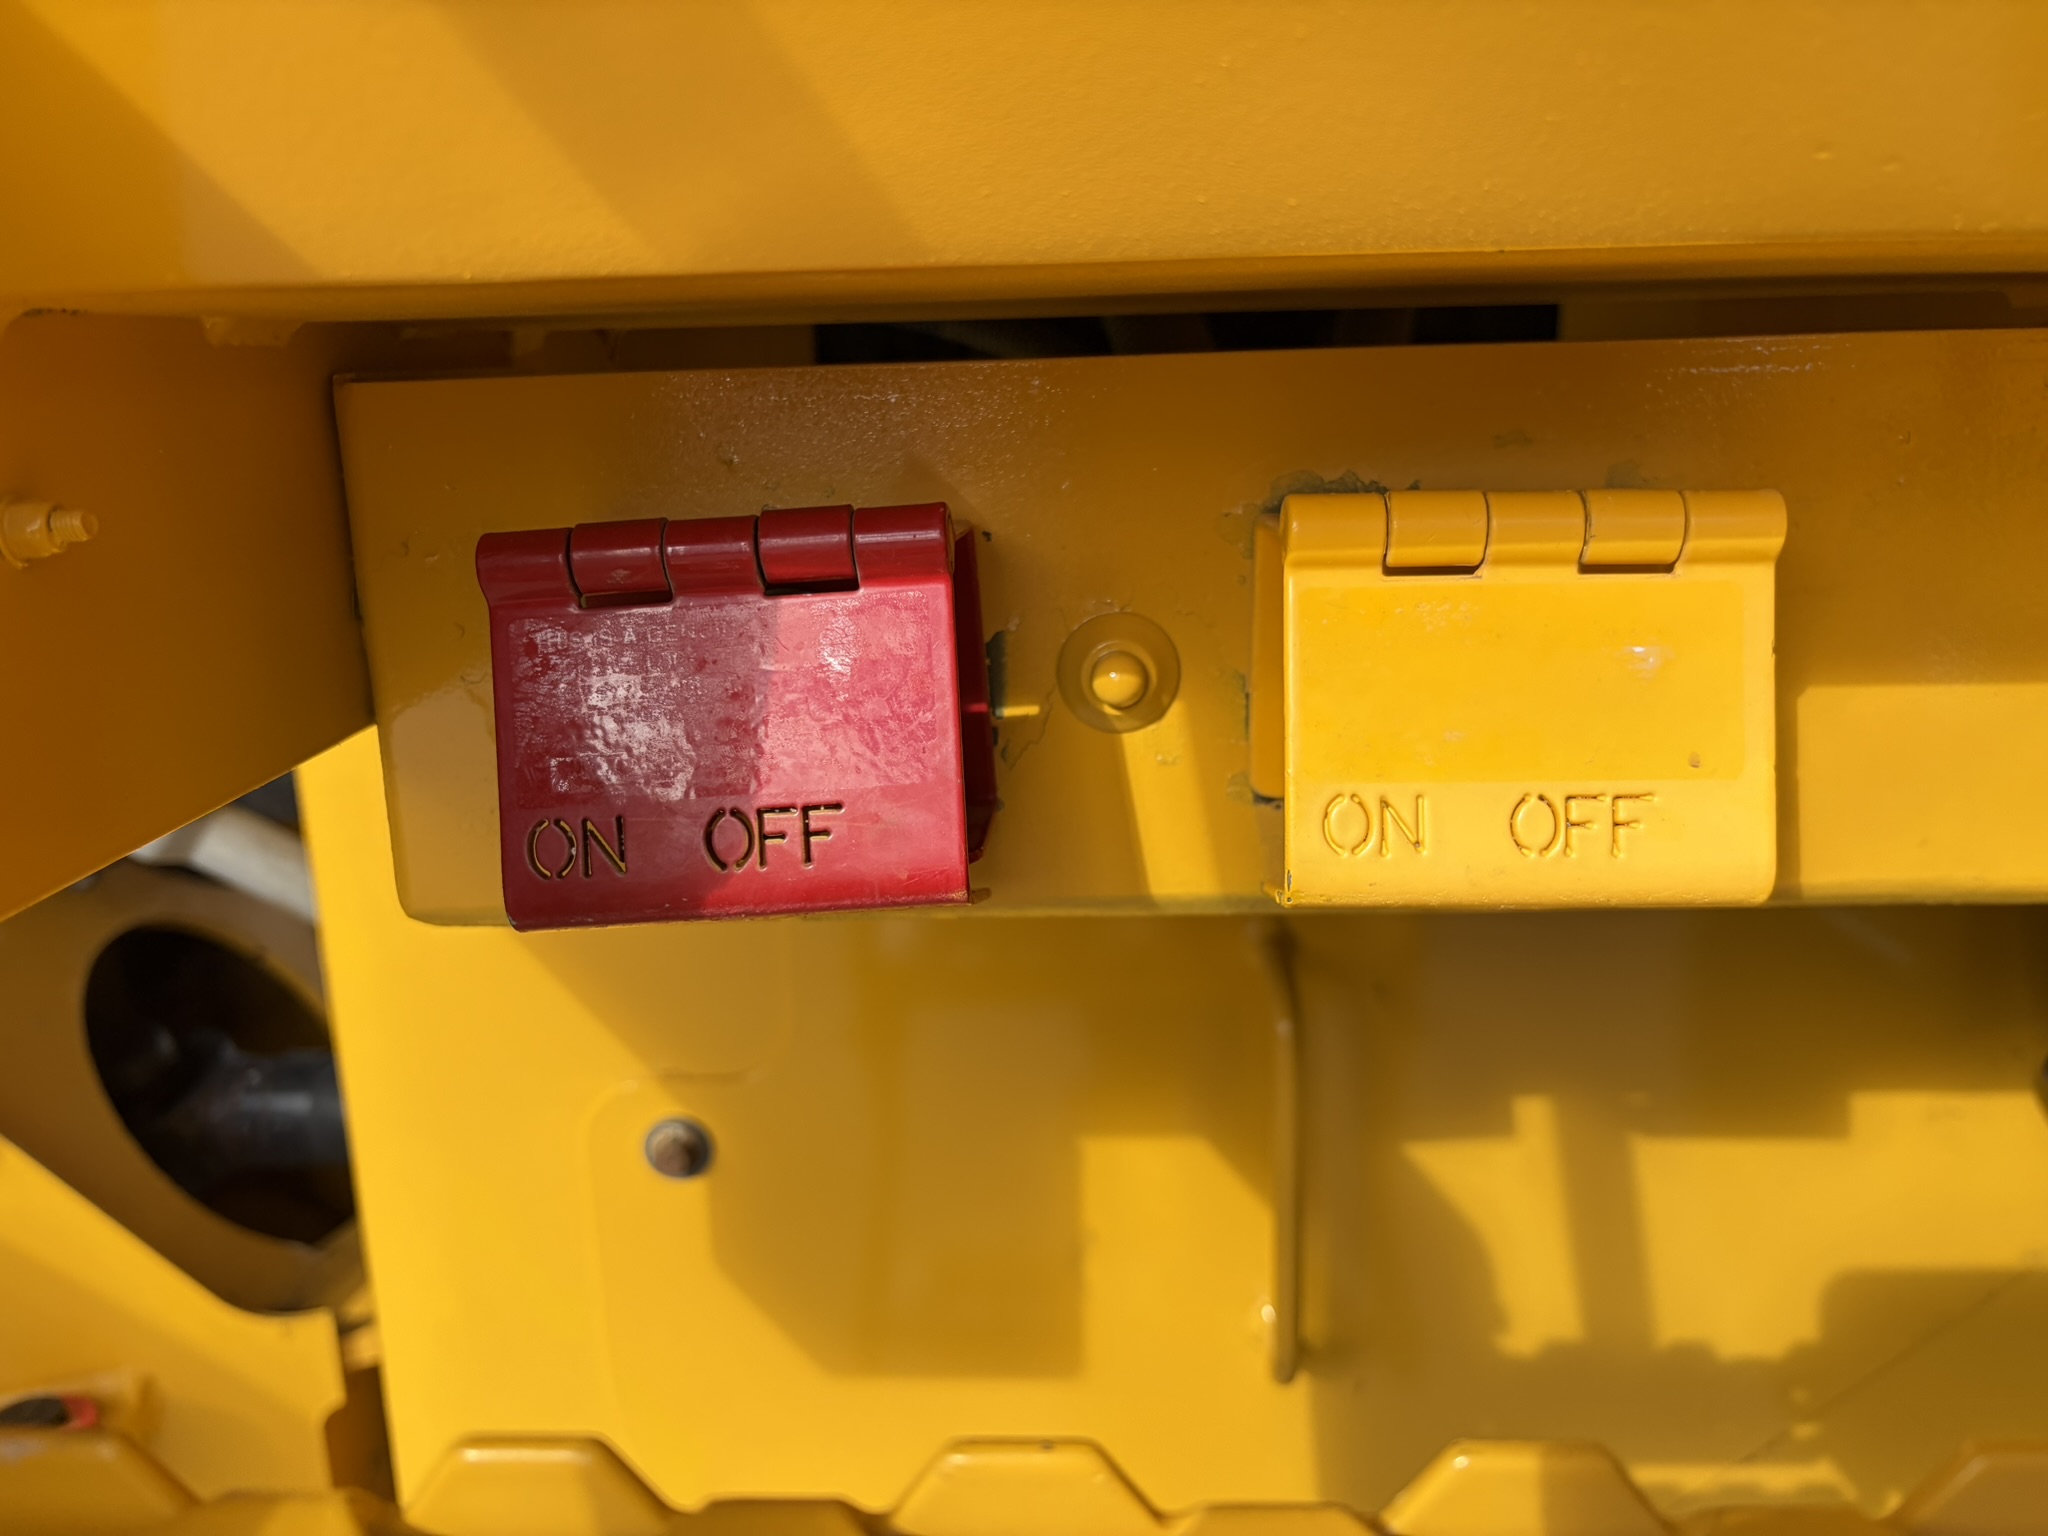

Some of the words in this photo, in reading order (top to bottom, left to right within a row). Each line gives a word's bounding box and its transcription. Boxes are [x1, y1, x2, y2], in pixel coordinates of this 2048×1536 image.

[527, 815, 628, 879] ON
[703, 803, 845, 872] OFF
[1322, 793, 1430, 857] ON
[1509, 792, 1655, 857] OFF
